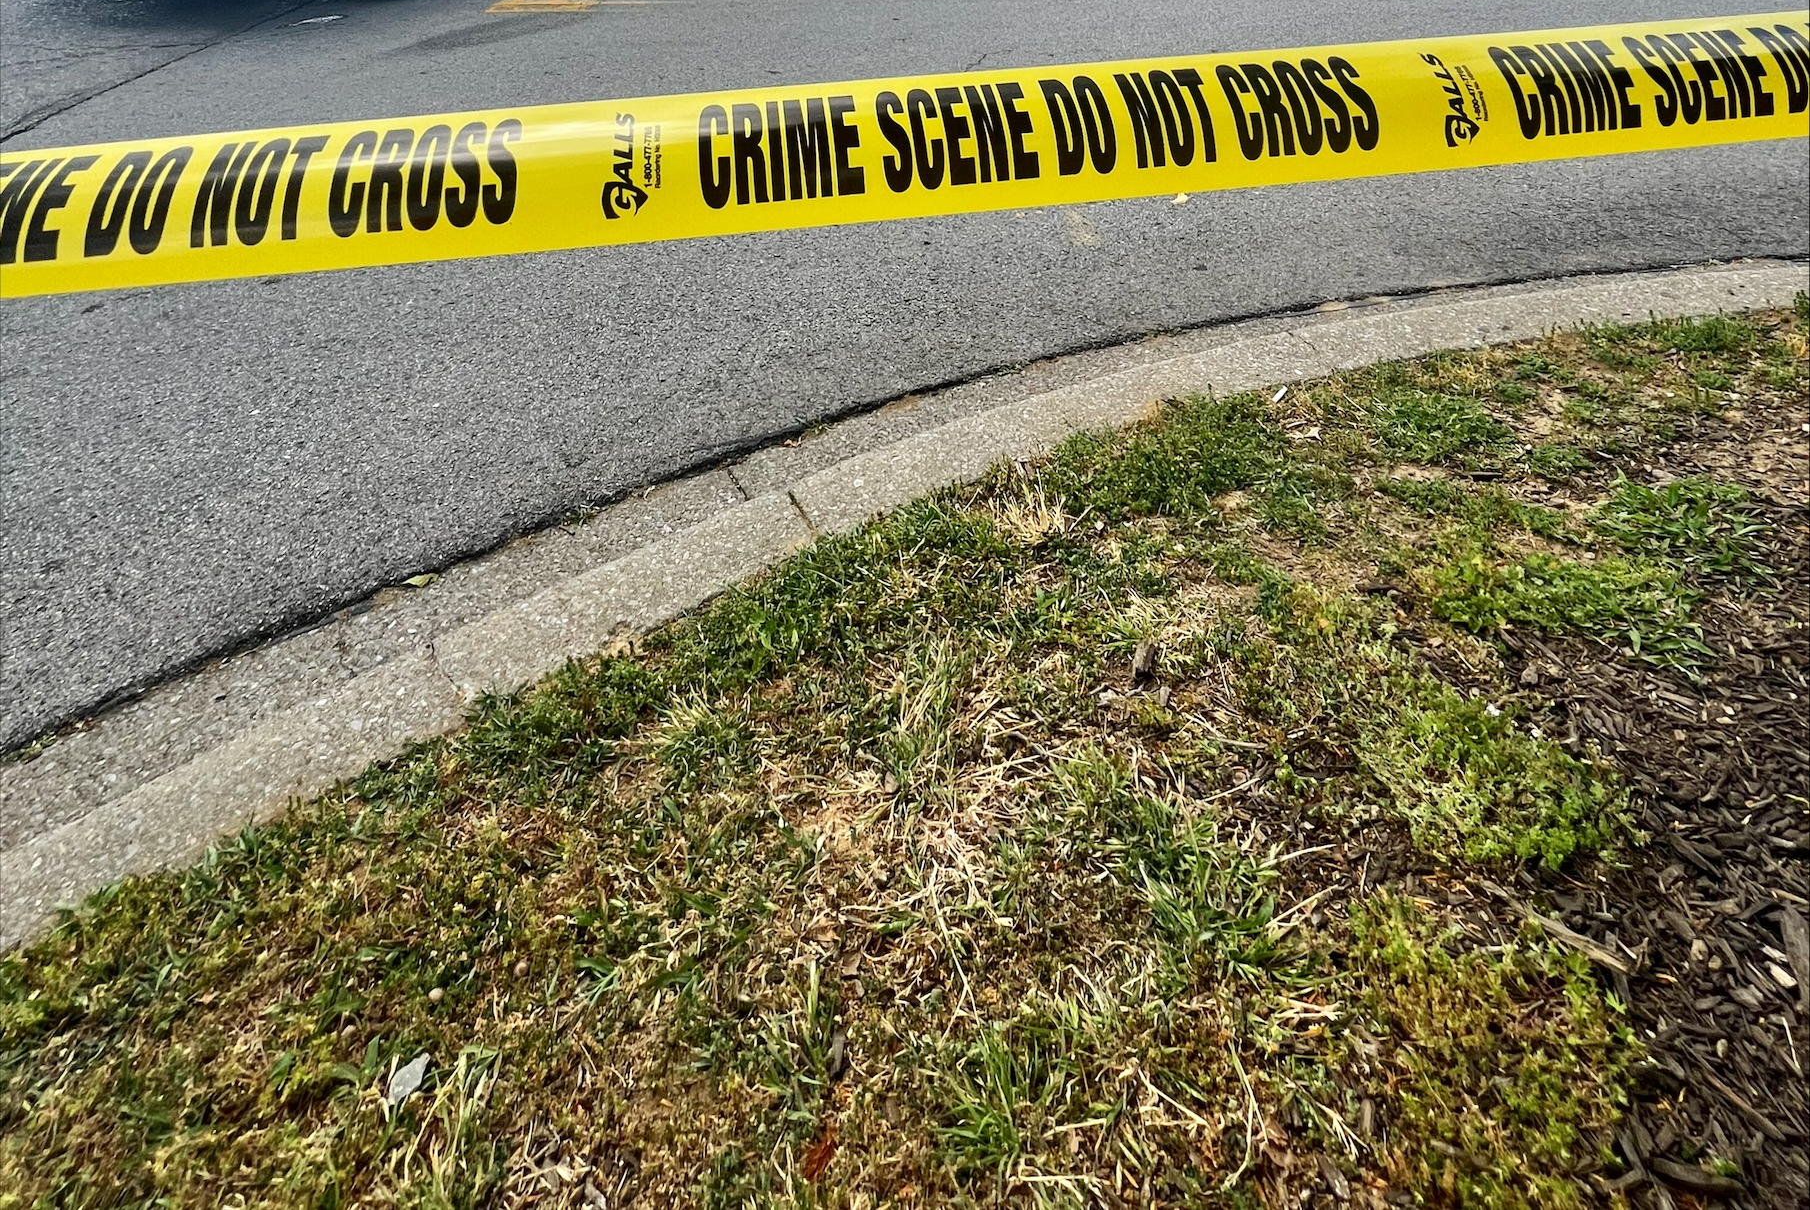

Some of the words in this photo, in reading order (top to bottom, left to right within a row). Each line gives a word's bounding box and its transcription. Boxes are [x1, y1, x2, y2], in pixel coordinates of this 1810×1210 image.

[698, 96, 866, 210] CRIME
[874, 82, 1041, 194] SCENE
[1037, 75, 1117, 177] DO
[1112, 68, 1217, 170] NOT
[1216, 56, 1380, 161] CROSS
[1418, 53, 1480, 147] GALLS
[1487, 39, 1642, 140] CRIME
[1621, 28, 1775, 128] SCENE
[0, 155, 103, 265] NE
[84, 147, 193, 258] DO
[190, 136, 331, 249] NOT
[328, 119, 524, 238] CROSS
[602, 112, 649, 220] GALLS
